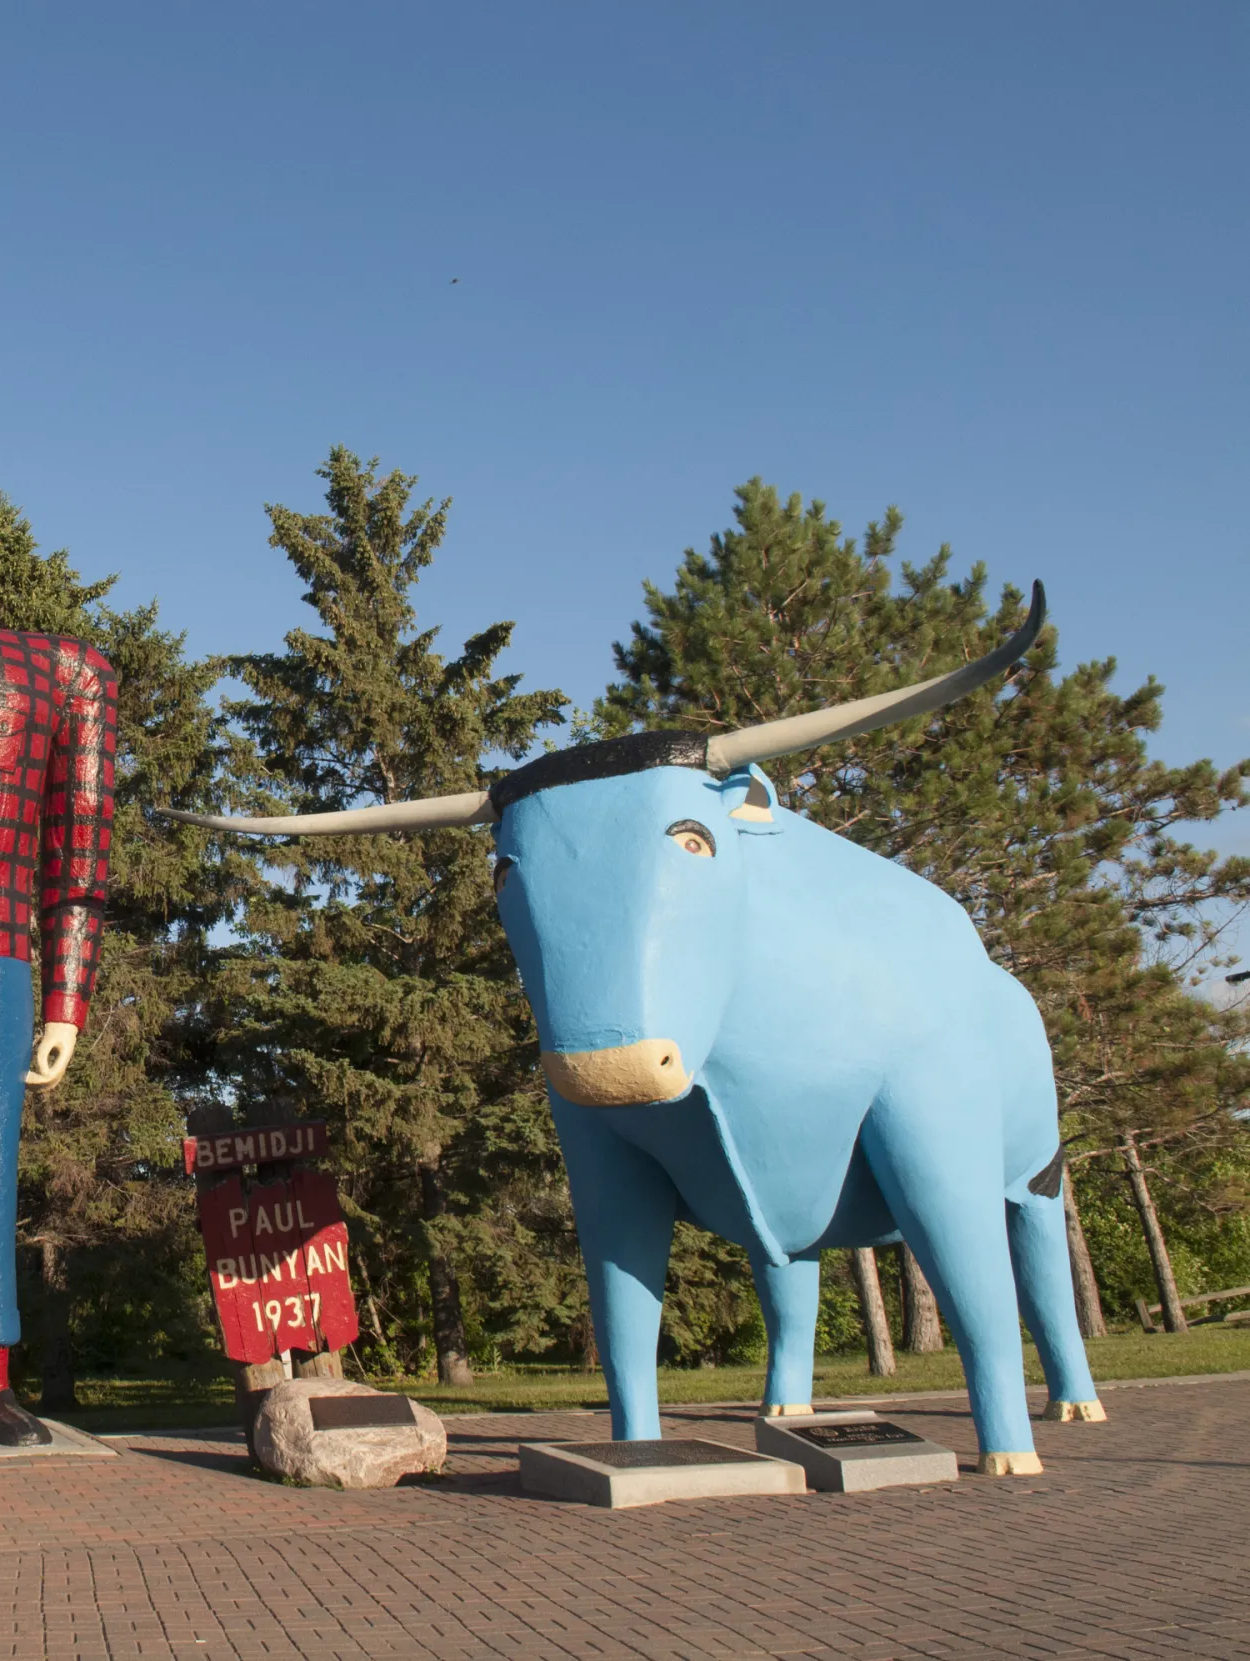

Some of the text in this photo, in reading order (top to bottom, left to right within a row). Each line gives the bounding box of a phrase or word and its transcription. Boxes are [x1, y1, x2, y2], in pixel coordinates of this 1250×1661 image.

[197, 1128, 314, 1167] BEMIDJI
[229, 1200, 314, 1238] PAUL
[216, 1241, 348, 1289] BUNYAN
[252, 1292, 322, 1332] 1937
